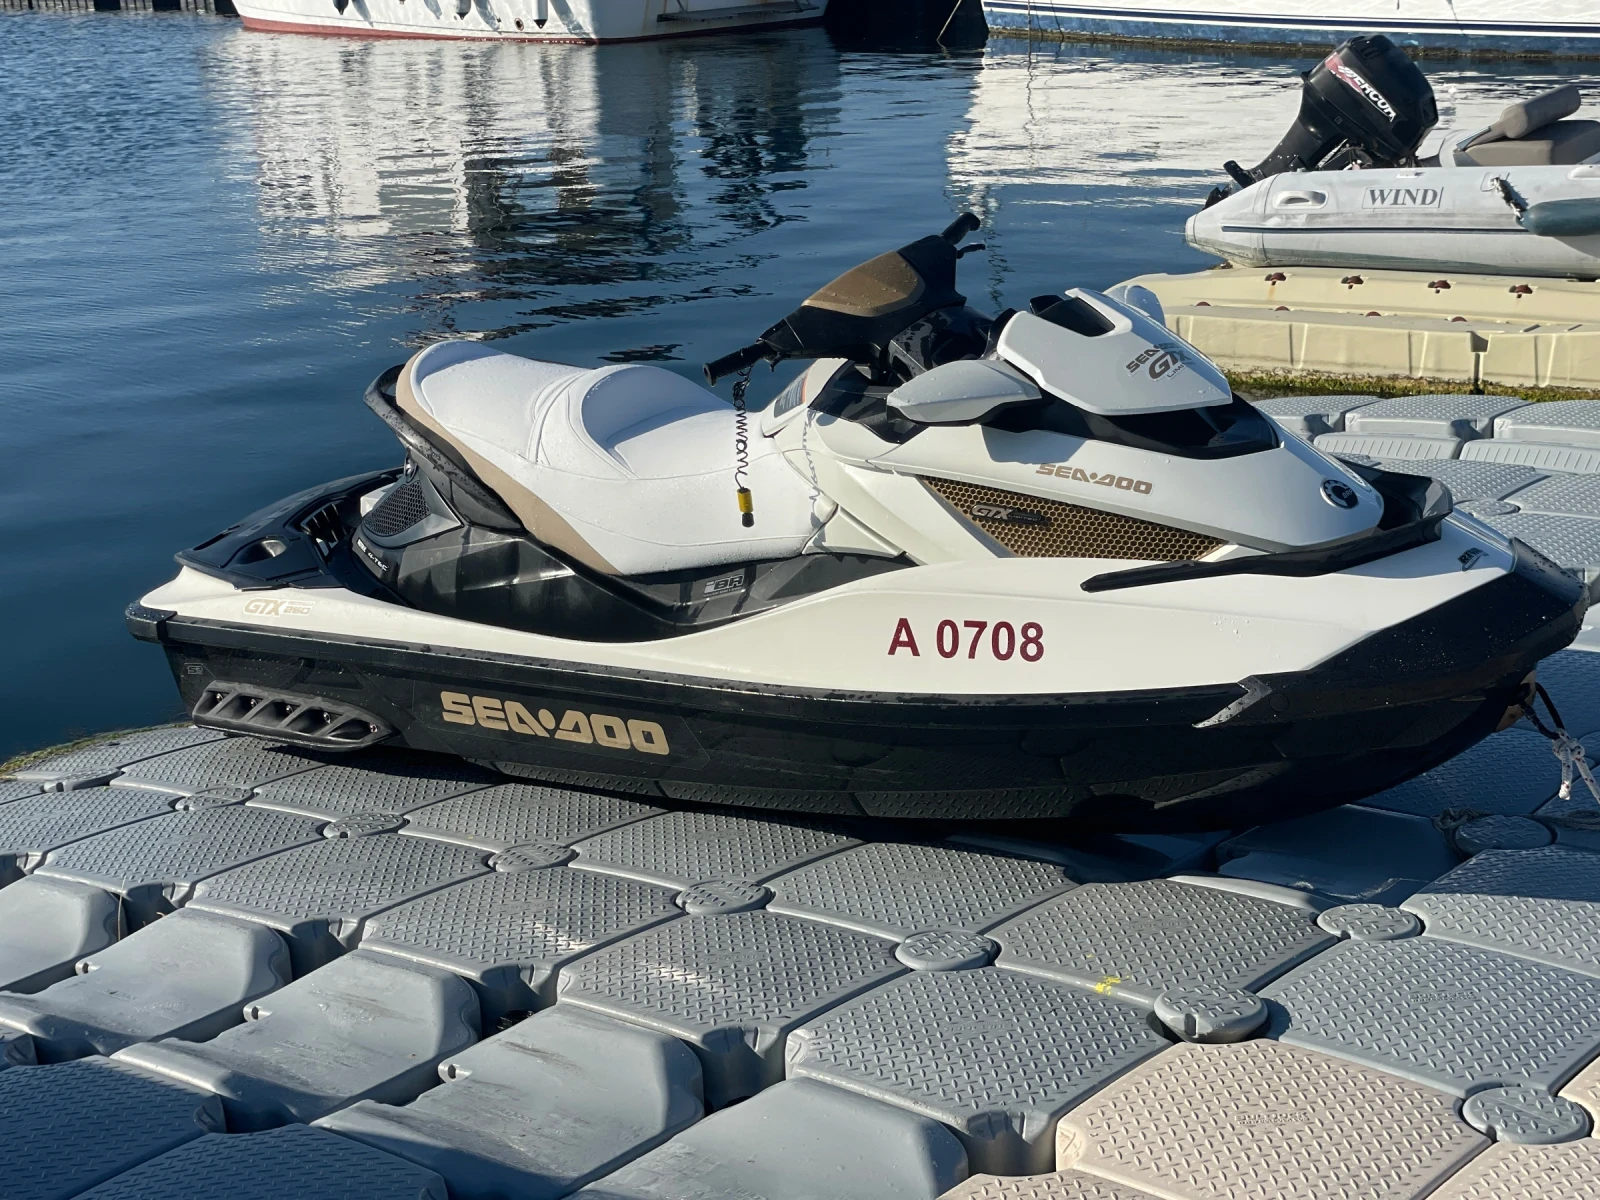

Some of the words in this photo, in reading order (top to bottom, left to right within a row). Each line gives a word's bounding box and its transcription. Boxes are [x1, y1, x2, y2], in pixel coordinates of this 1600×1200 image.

[1369, 188, 1438, 206] WIND
[1148, 350, 1192, 380] GTX
[971, 504, 1013, 520] GTX
[244, 598, 287, 616] GTX
[887, 617, 921, 657] A
[936, 619, 1045, 663] 0708
